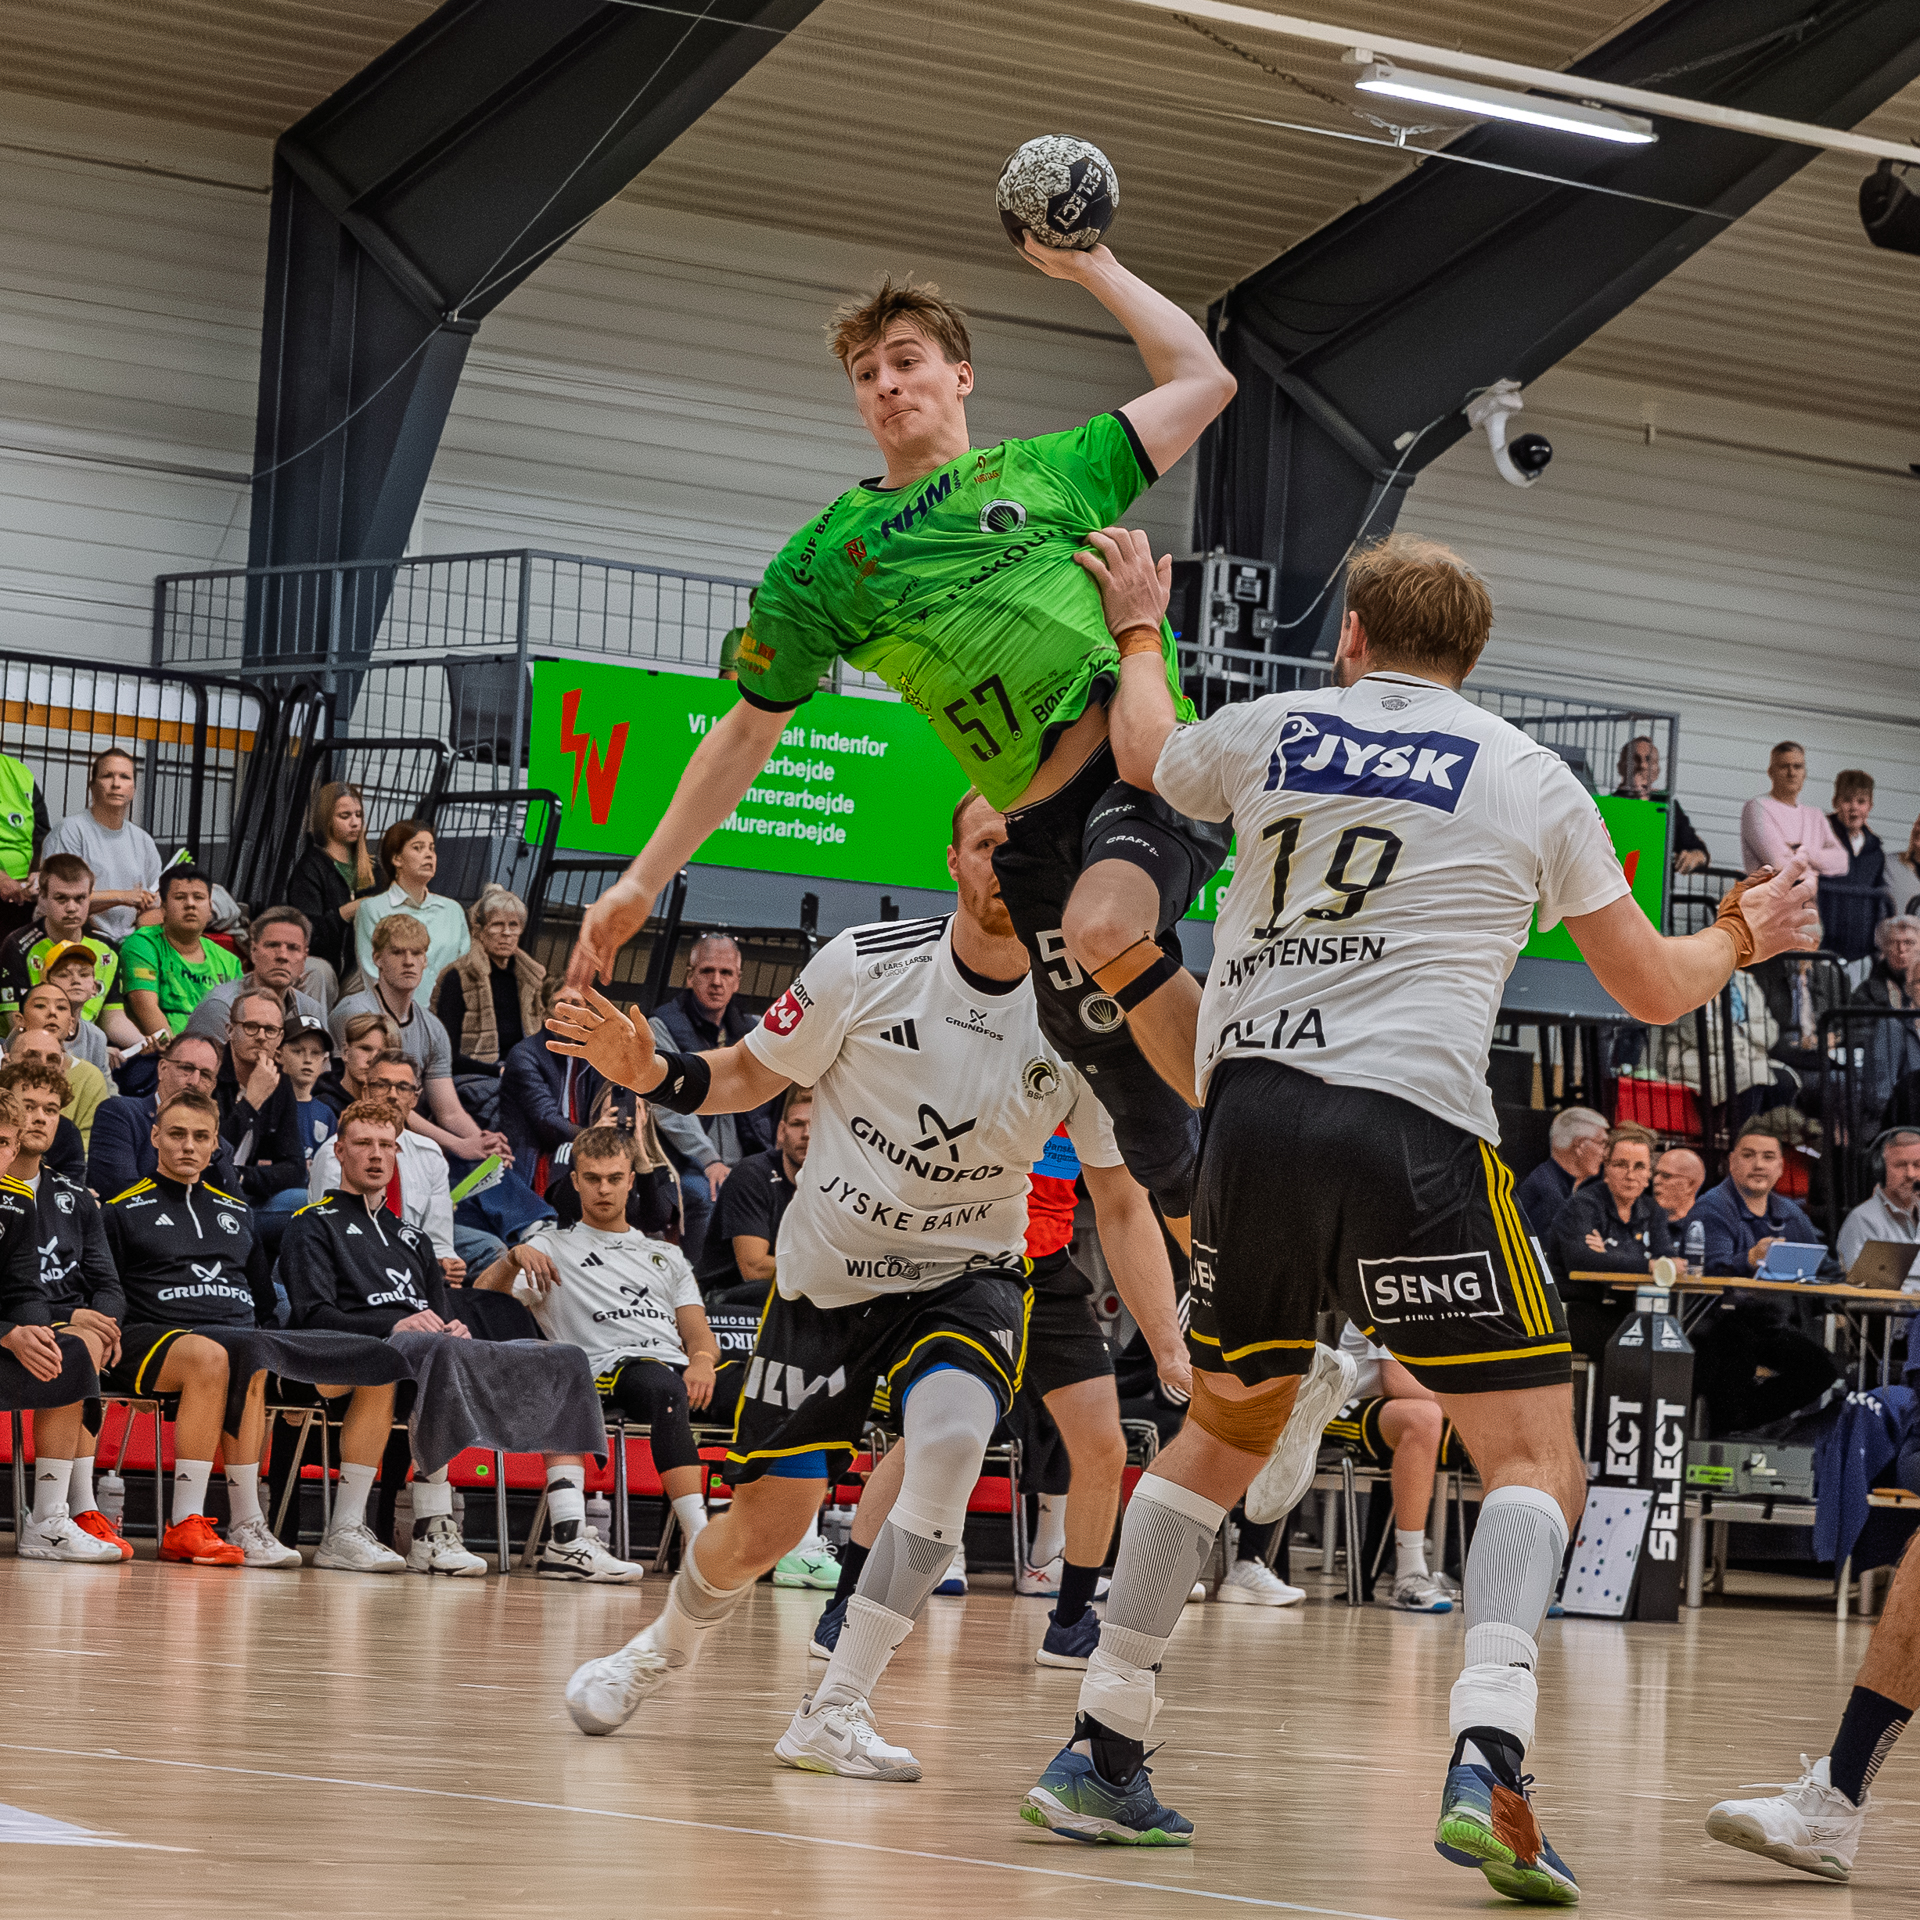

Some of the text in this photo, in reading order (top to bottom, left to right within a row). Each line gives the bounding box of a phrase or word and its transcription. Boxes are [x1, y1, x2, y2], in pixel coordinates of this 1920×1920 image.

[800, 491, 850, 565] SJF BAN
[688, 713, 706, 735] Vi
[780, 726, 806, 748] alt
[810, 728, 888, 757] indenfor
[942, 673, 1023, 762] 57
[763, 756, 835, 783] arbejde
[1301, 733, 1464, 791] JYSK
[720, 811, 847, 845] Murerarbejde
[1106, 835, 1150, 847] CRAFT
[1251, 816, 1404, 940] 19
[883, 955, 933, 971] LARS LARSEN
[945, 1016, 1004, 1042] GRUNDFOS
[851, 1116, 1004, 1183] GRUNDFOS
[820, 1176, 994, 1233] JYSKE BANK
[158, 1284, 255, 1308] GRUNDFOS
[1375, 1272, 1482, 1306] SENG
[1605, 1396, 1643, 1484] ECT
[1648, 1398, 1687, 1561] SELECT
